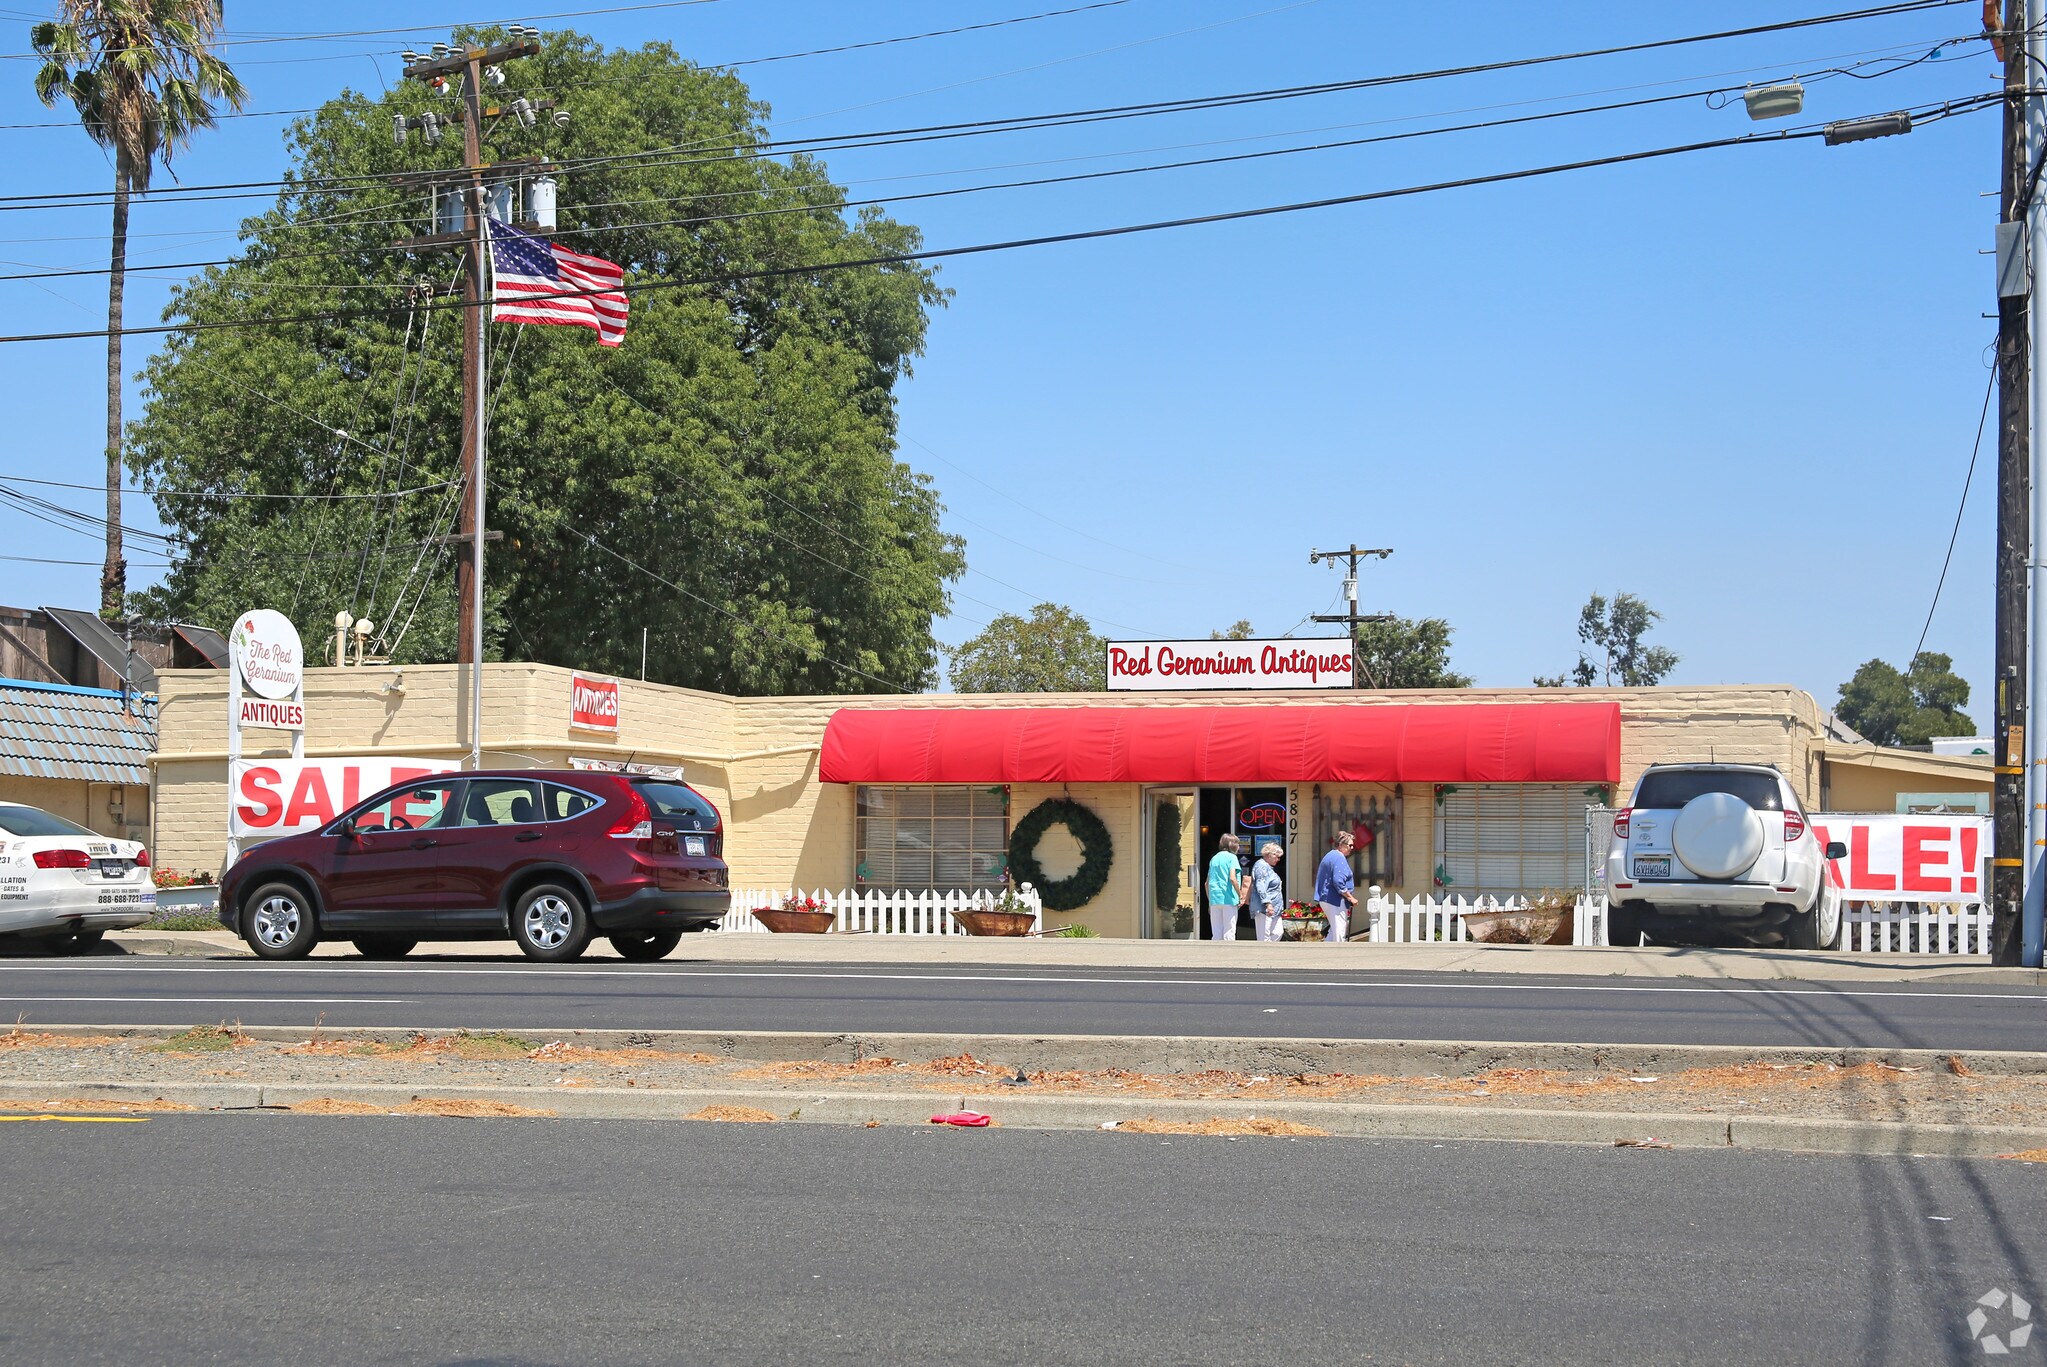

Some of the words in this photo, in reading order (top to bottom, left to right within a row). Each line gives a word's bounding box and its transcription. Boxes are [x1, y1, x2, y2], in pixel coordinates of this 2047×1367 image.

[250, 639, 270, 659] The
[272, 643, 293, 667] Red
[1109, 646, 1153, 676] Red
[1157, 646, 1256, 676] Geranium
[1260, 645, 1352, 683] Antiques
[245, 660, 296, 685] Geranium
[241, 702, 303, 726] ANTIQUES
[574, 686, 617, 717] ANTIQUES
[1240, 808, 1285, 824] OPEN
[1290, 789, 1298, 844] 5807
